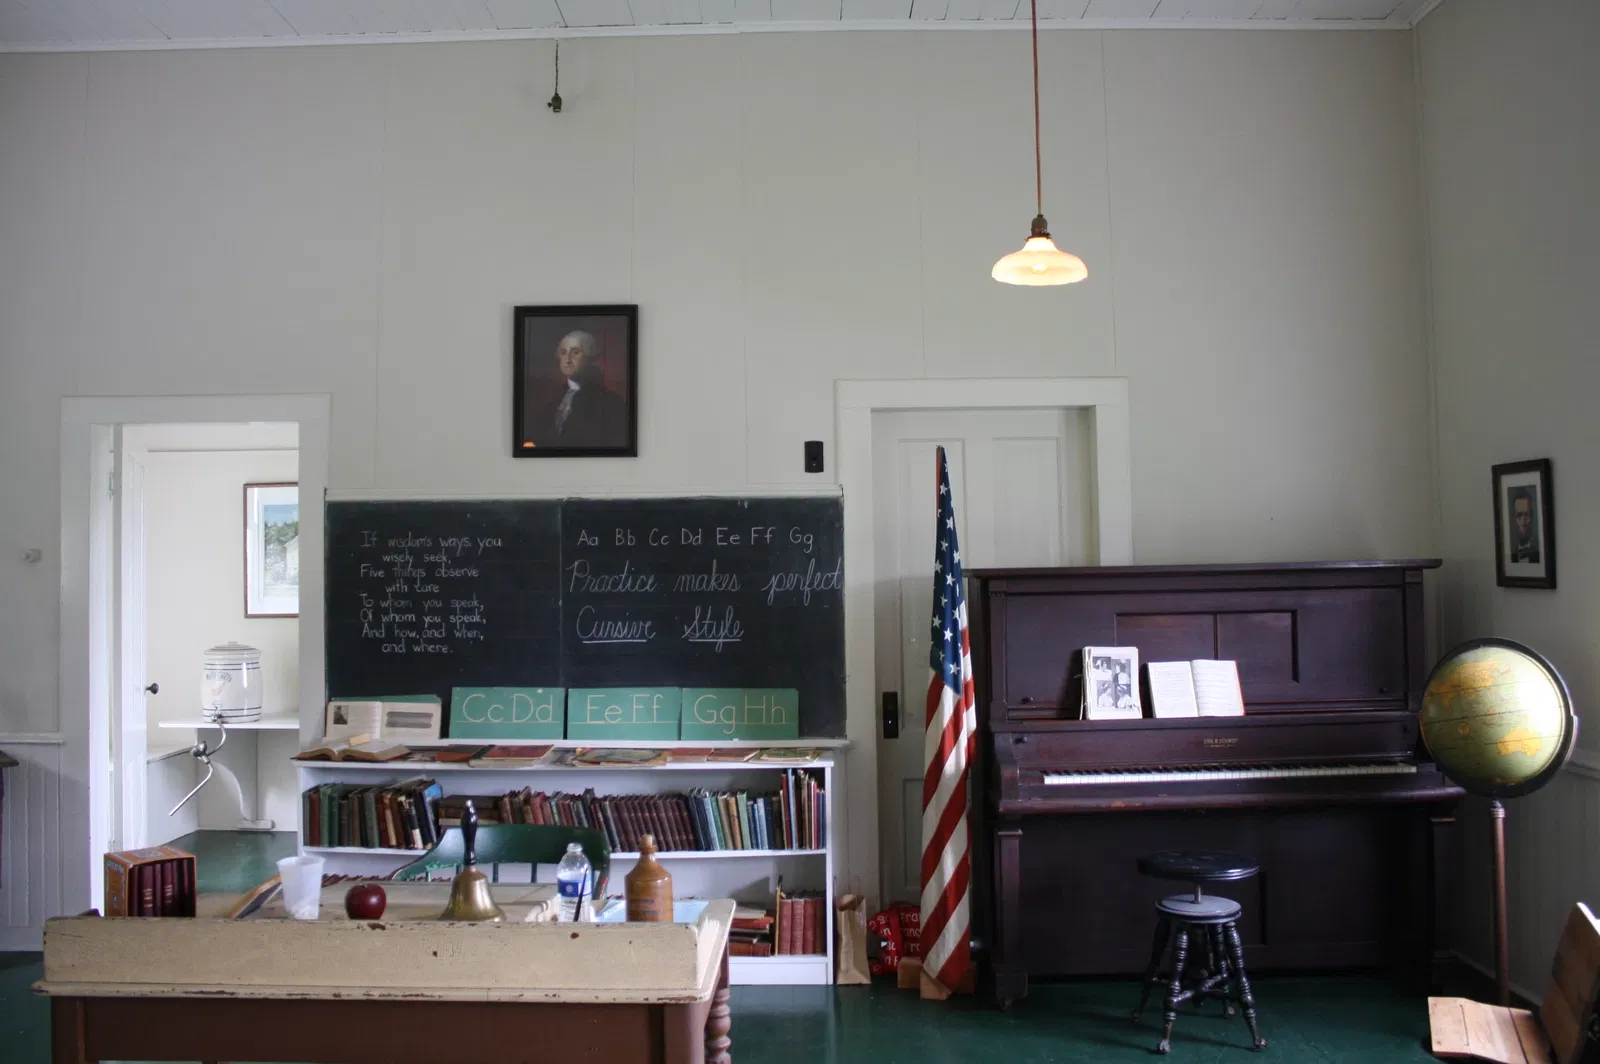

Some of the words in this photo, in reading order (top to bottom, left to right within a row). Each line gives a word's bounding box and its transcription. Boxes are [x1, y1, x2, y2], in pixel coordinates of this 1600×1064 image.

[477, 536, 503, 556] you
[577, 529, 599, 546] Aa
[615, 528, 636, 546] Bb
[650, 528, 669, 546] Cc
[681, 528, 702, 546] Dd
[716, 527, 740, 546] Ee
[751, 527, 776, 545] Ff
[789, 527, 813, 553] Gg
[382, 548, 414, 568] wisely
[360, 564, 385, 578] Five
[392, 562, 426, 582] things
[435, 563, 480, 578] observe
[565, 559, 657, 593] Practice
[673, 558, 740, 592] makes
[761, 558, 843, 606] perfect
[385, 578, 408, 593] with
[413, 582, 440, 593] care
[360, 593, 374, 608] To
[380, 593, 412, 608] whom
[422, 599, 442, 612] you
[381, 609, 416, 623] whom
[422, 614, 442, 629] you
[576, 605, 657, 640] Cursive
[681, 605, 744, 653] Style
[361, 623, 385, 638] And
[422, 622, 446, 638] and
[381, 638, 406, 654] and
[463, 694, 504, 723] Cc
[512, 694, 553, 723] Dd
[587, 694, 622, 723] Ee
[631, 693, 664, 723] Ff
[694, 694, 736, 734] Gg
[745, 695, 786, 724] Hh
